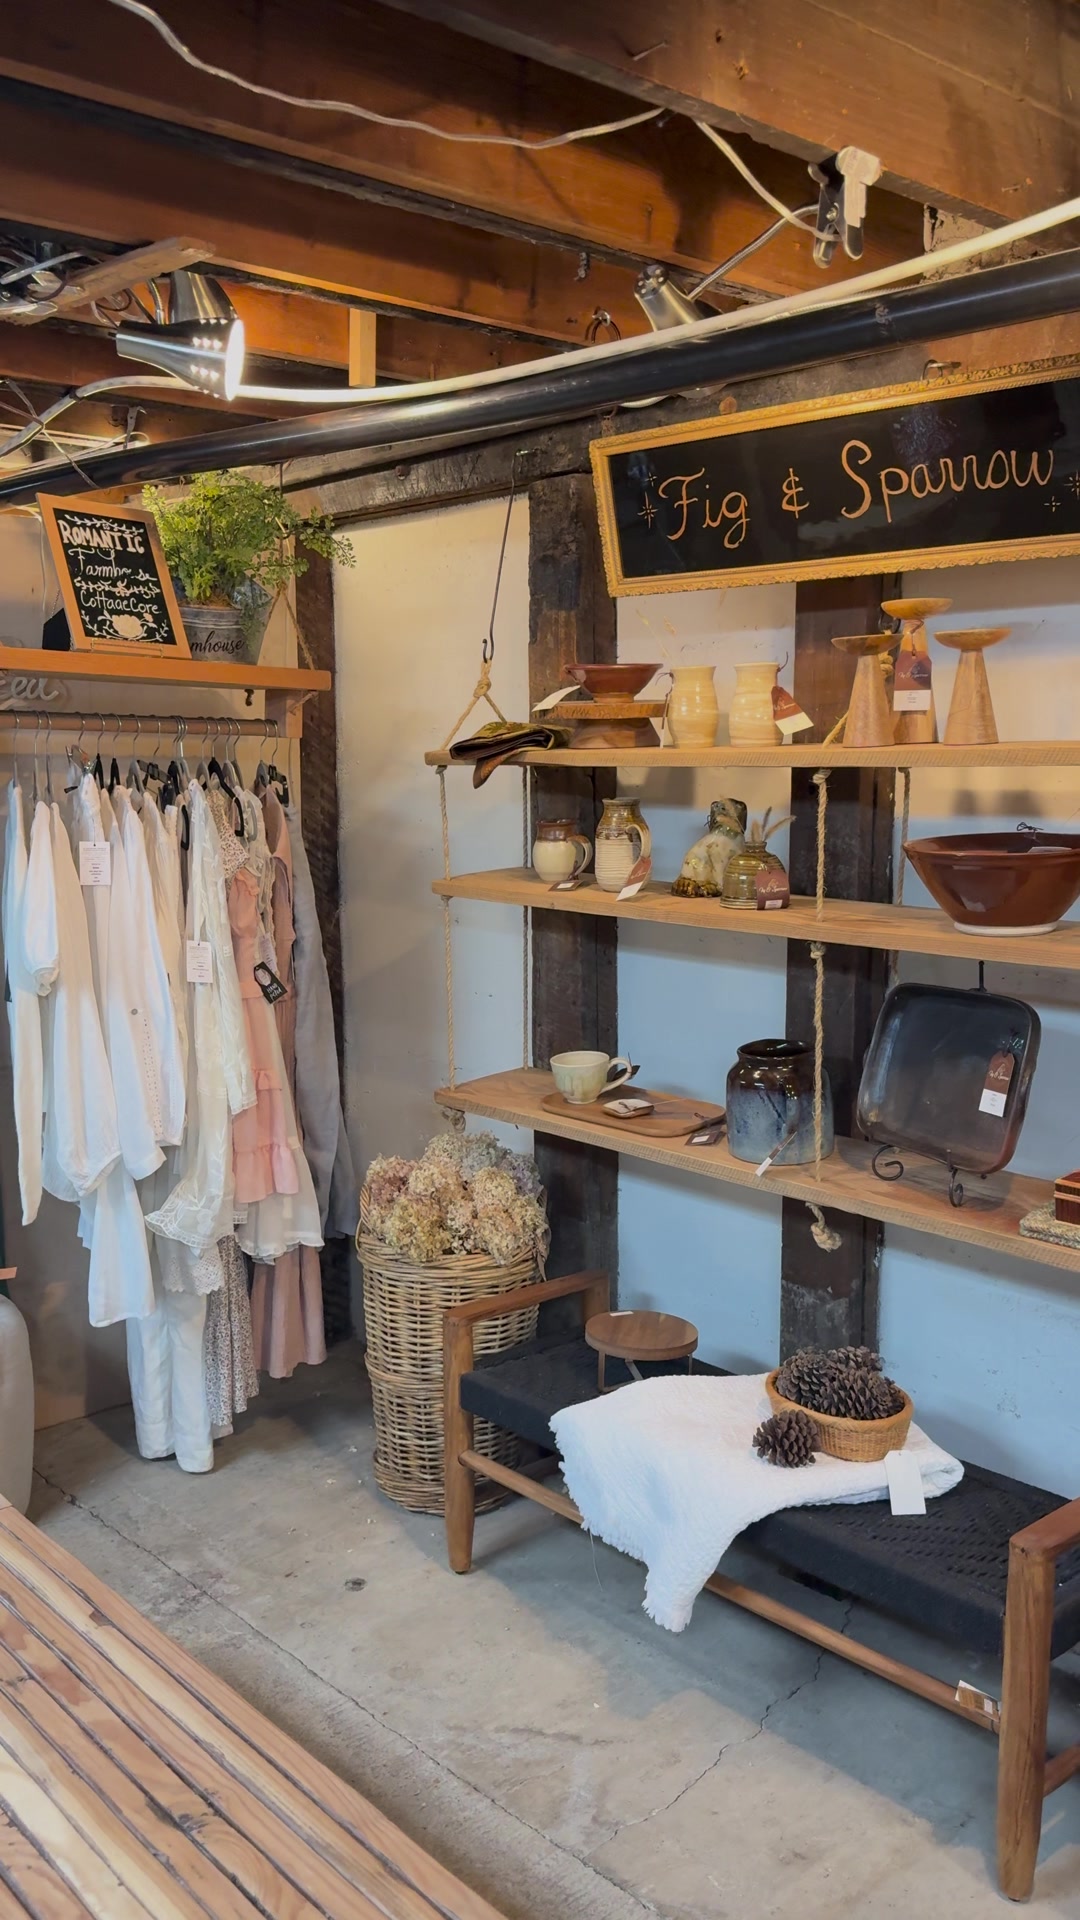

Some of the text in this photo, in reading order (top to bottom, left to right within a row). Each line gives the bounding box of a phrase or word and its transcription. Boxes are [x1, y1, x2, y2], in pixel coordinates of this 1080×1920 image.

[658, 439, 1054, 548] Fig & Sparrow
[57, 519, 145, 554] ROMANTIC
